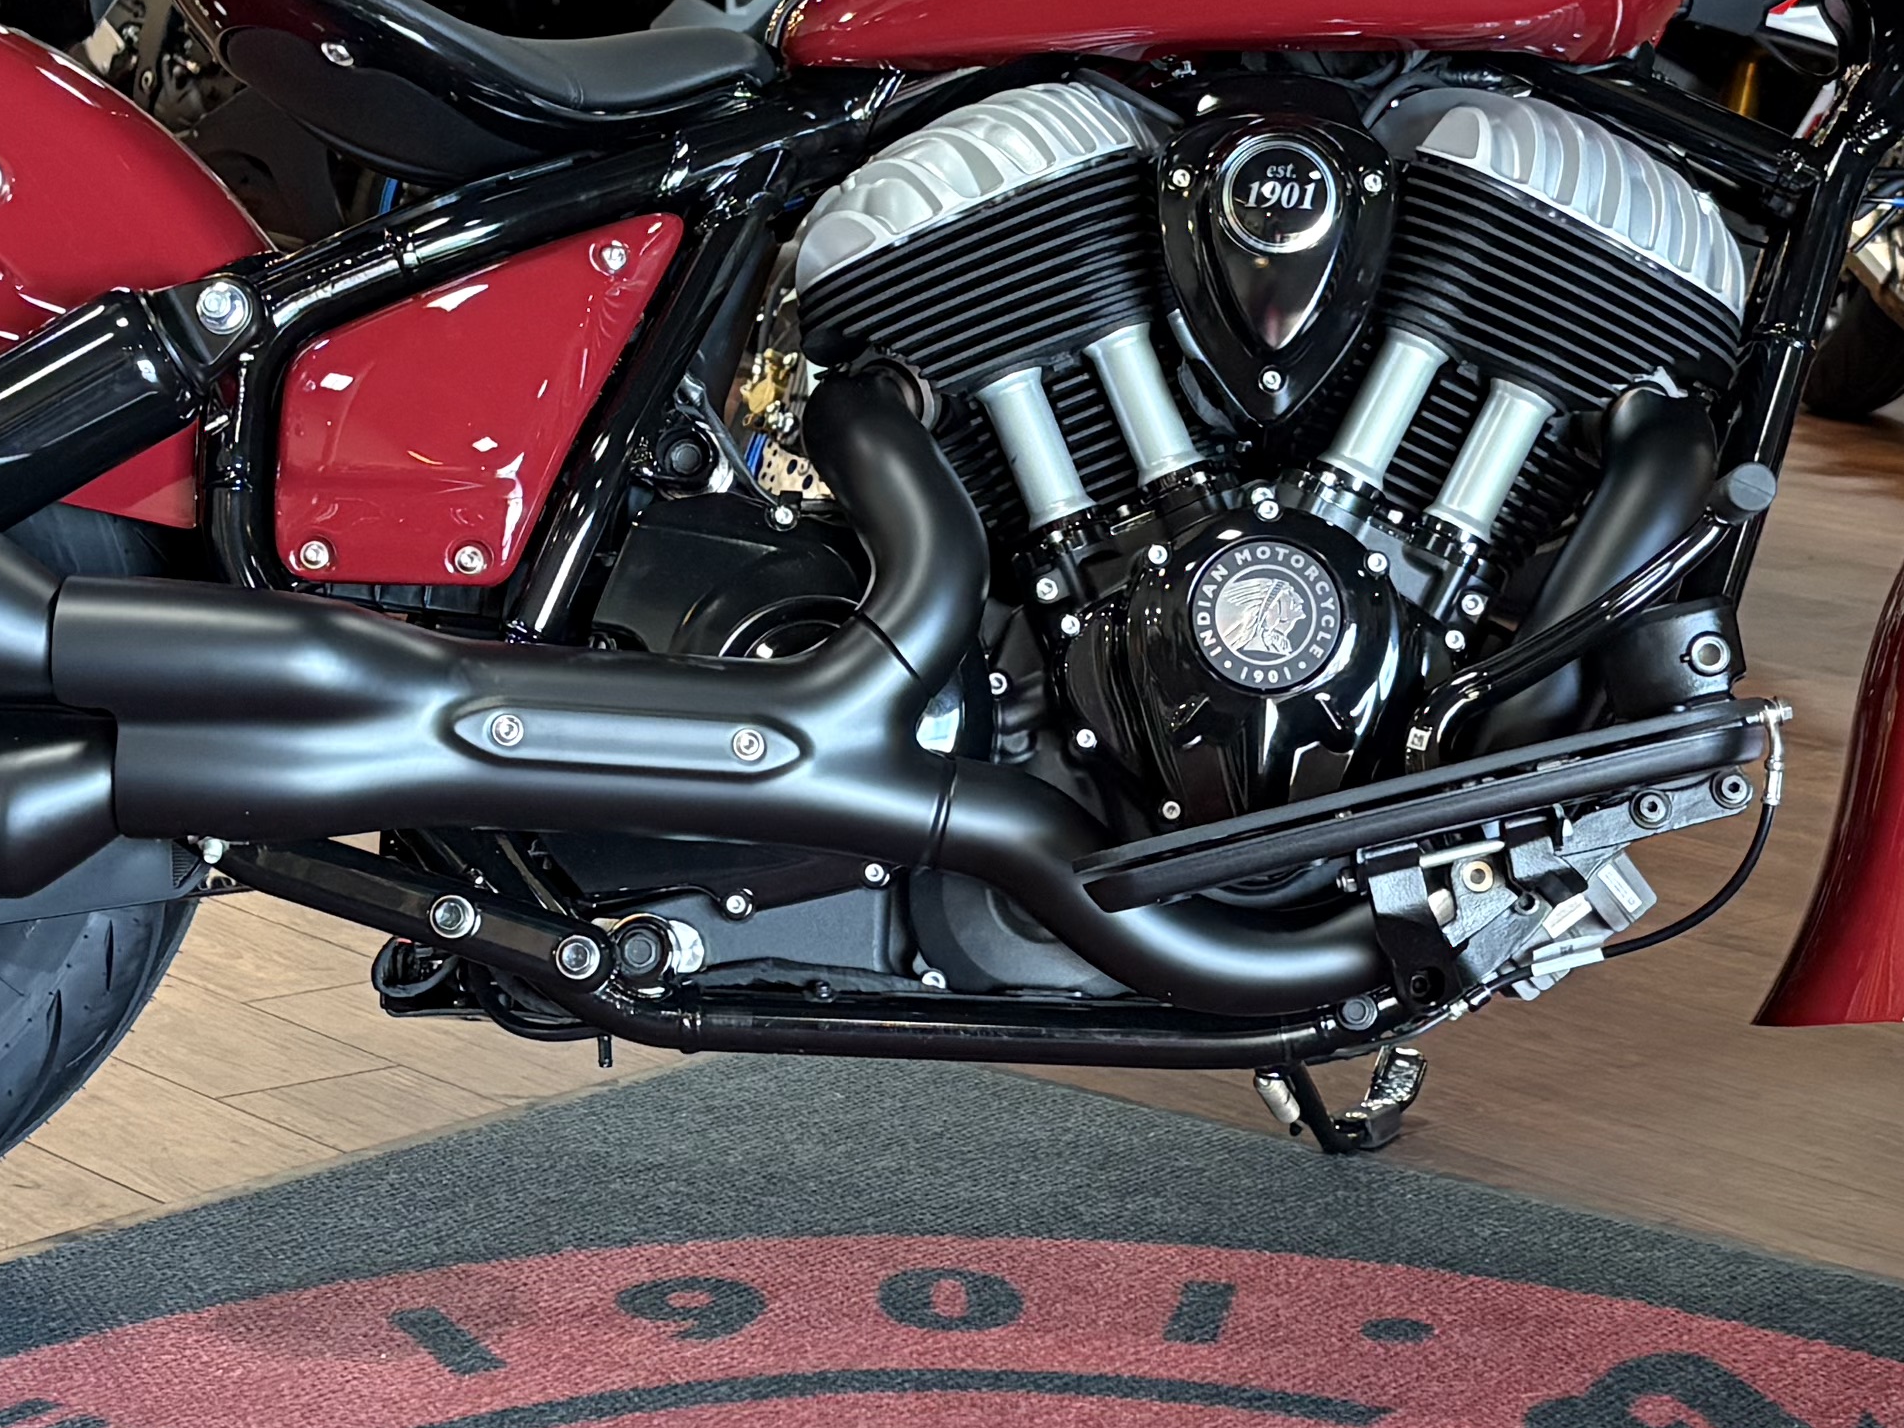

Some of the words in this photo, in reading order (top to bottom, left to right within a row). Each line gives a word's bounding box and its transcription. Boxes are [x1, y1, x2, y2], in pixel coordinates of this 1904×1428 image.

[1266, 163, 1297, 179] est.
[1244, 180, 1317, 210] 1901
[1196, 563, 1229, 657] INDIAN
[1234, 545, 1336, 659] MOTORCYCLE
[1240, 666, 1292, 684] 1901
[407, 1276, 1232, 1376] 1901
